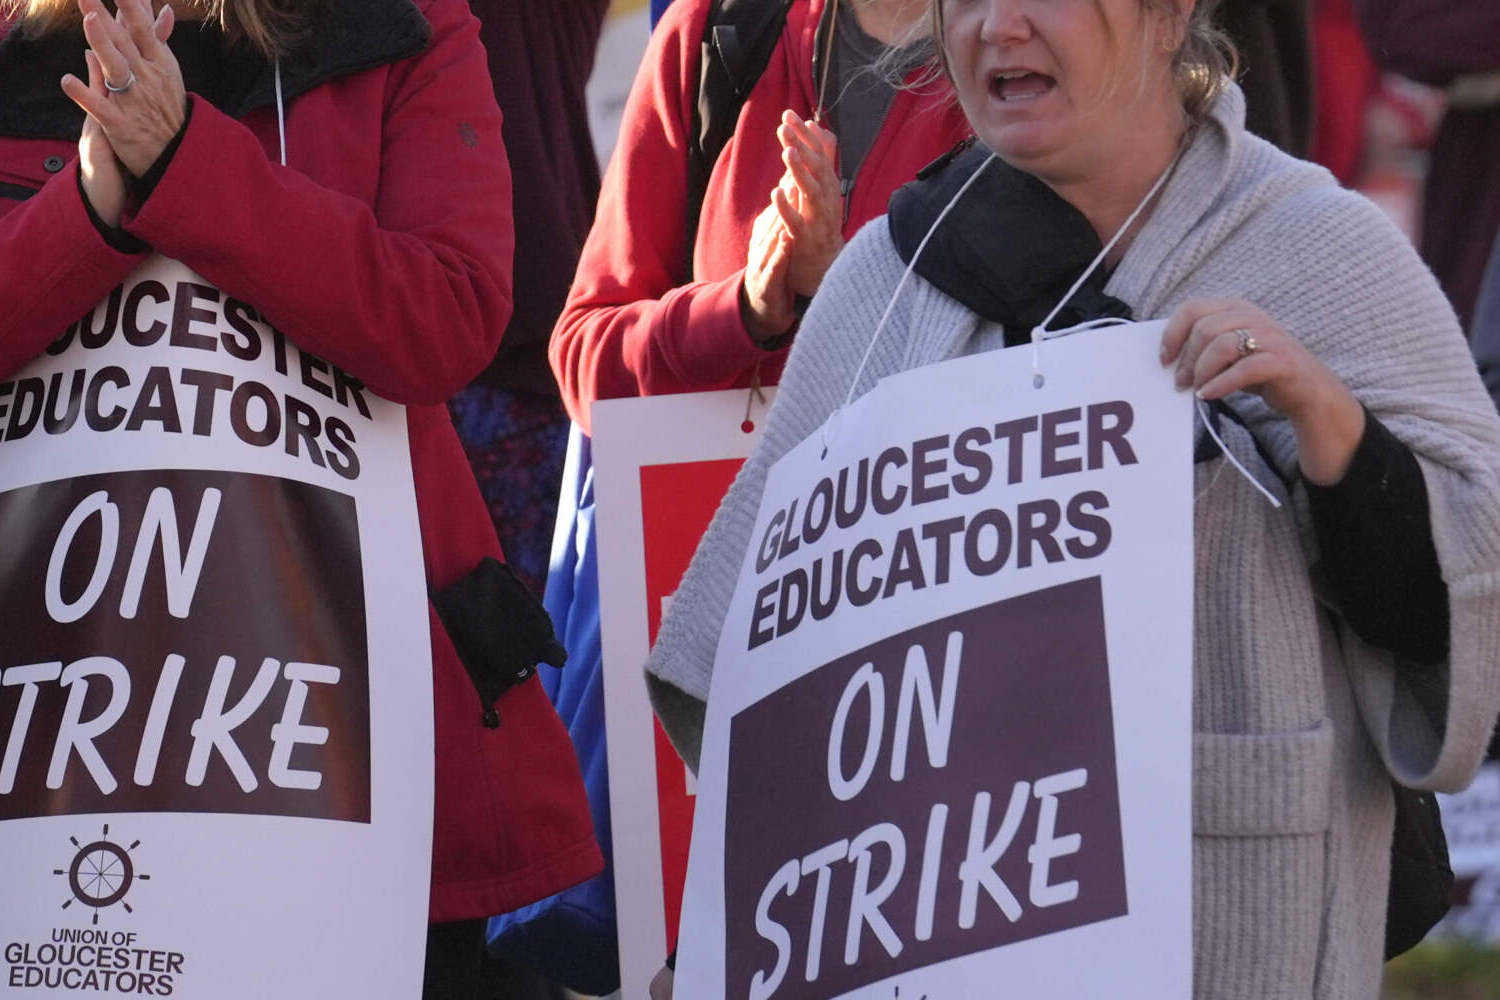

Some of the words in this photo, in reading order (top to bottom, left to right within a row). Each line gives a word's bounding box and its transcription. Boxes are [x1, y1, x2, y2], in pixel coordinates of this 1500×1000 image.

[44, 486, 222, 624] ON
[755, 400, 1140, 574] GLOUCESTER
[747, 490, 1113, 651] EDUCATORS
[827, 631, 964, 802] ON
[4, 942, 185, 974] GLOUCESTER
[51, 928, 108, 945] UNION
[111, 931, 137, 947] OF
[748, 768, 1089, 1000] STRIKE
[8, 965, 174, 996] EDUCATORS
